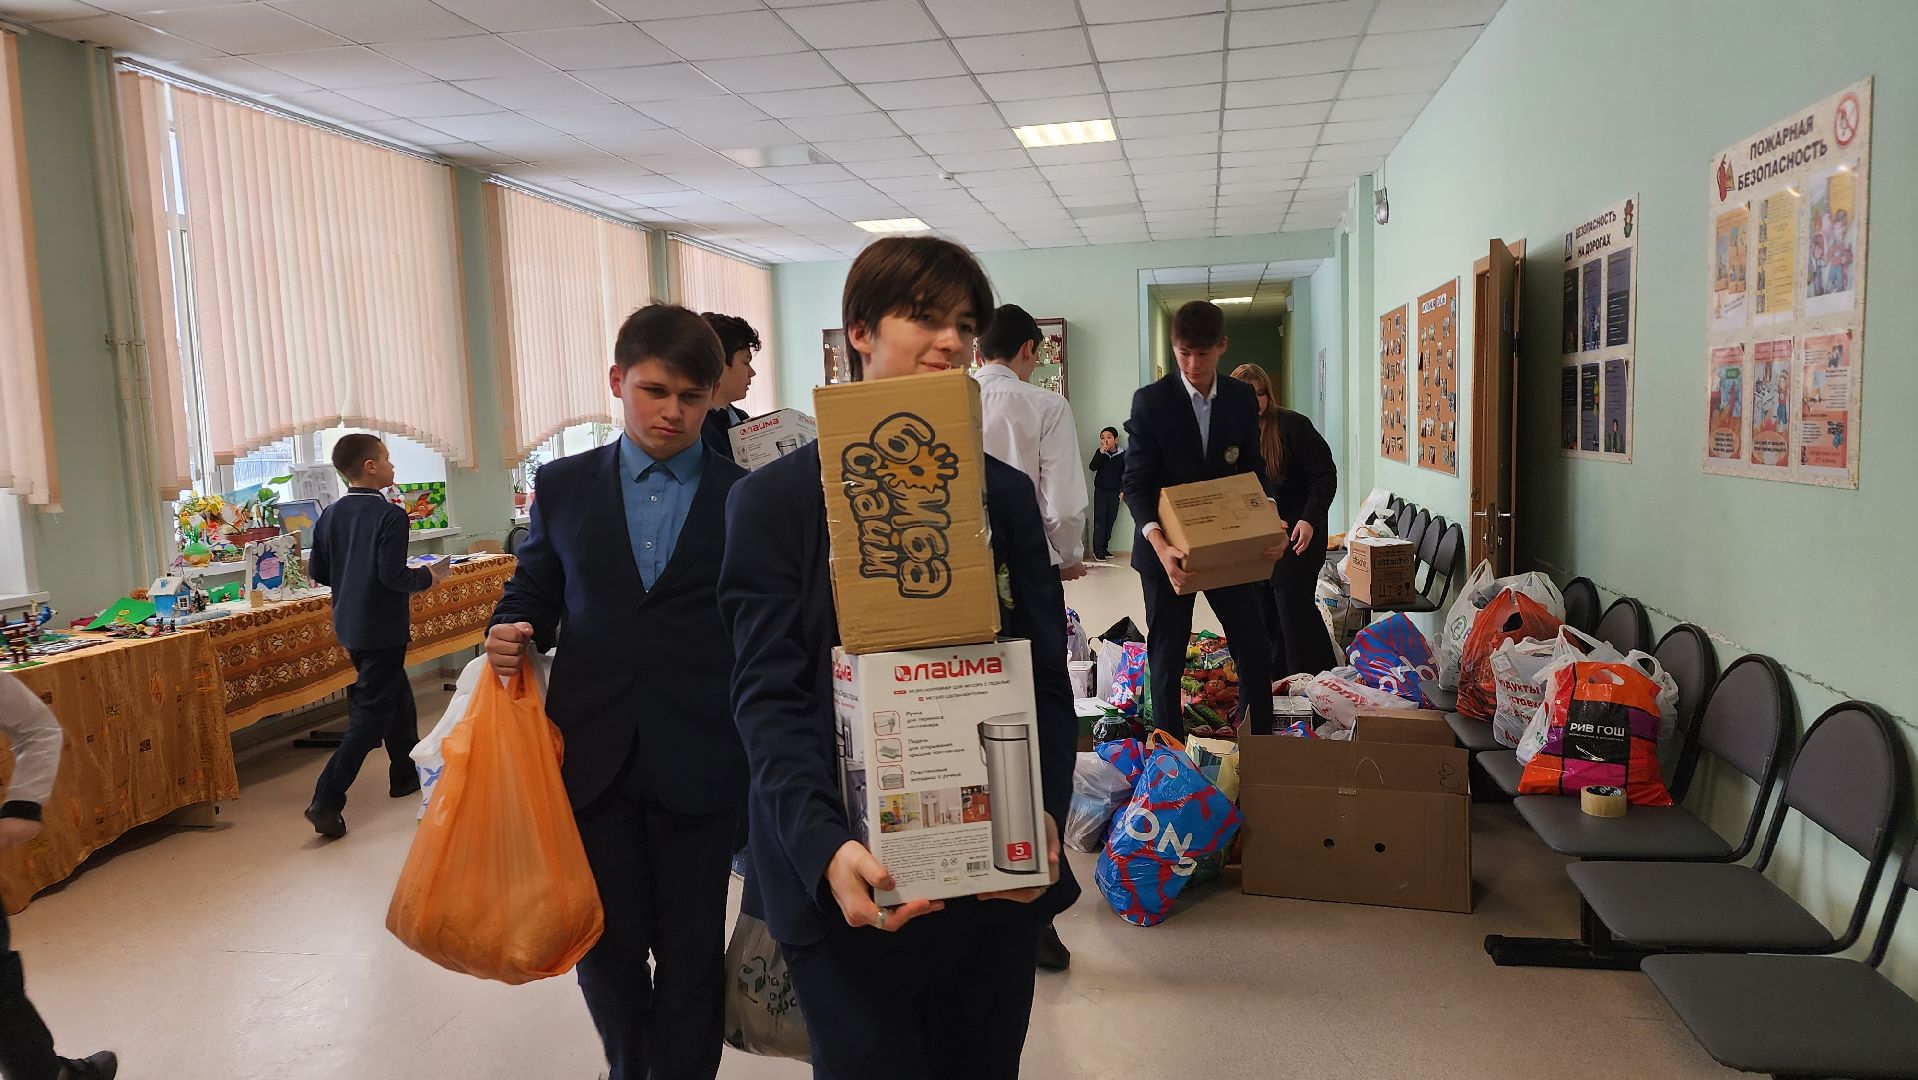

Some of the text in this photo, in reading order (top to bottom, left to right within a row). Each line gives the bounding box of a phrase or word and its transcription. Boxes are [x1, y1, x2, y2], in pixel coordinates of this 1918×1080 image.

[1750, 115, 1814, 160] ПОЖАРНАЯ
[1738, 138, 1828, 191] БЕЗОПАСНОСТЬ
[1575, 210, 1617, 240] БЕЗОПАСНОСТЬ
[1570, 722, 1625, 737] РИВ ГОШ
[1015, 844, 1025, 856] 5
